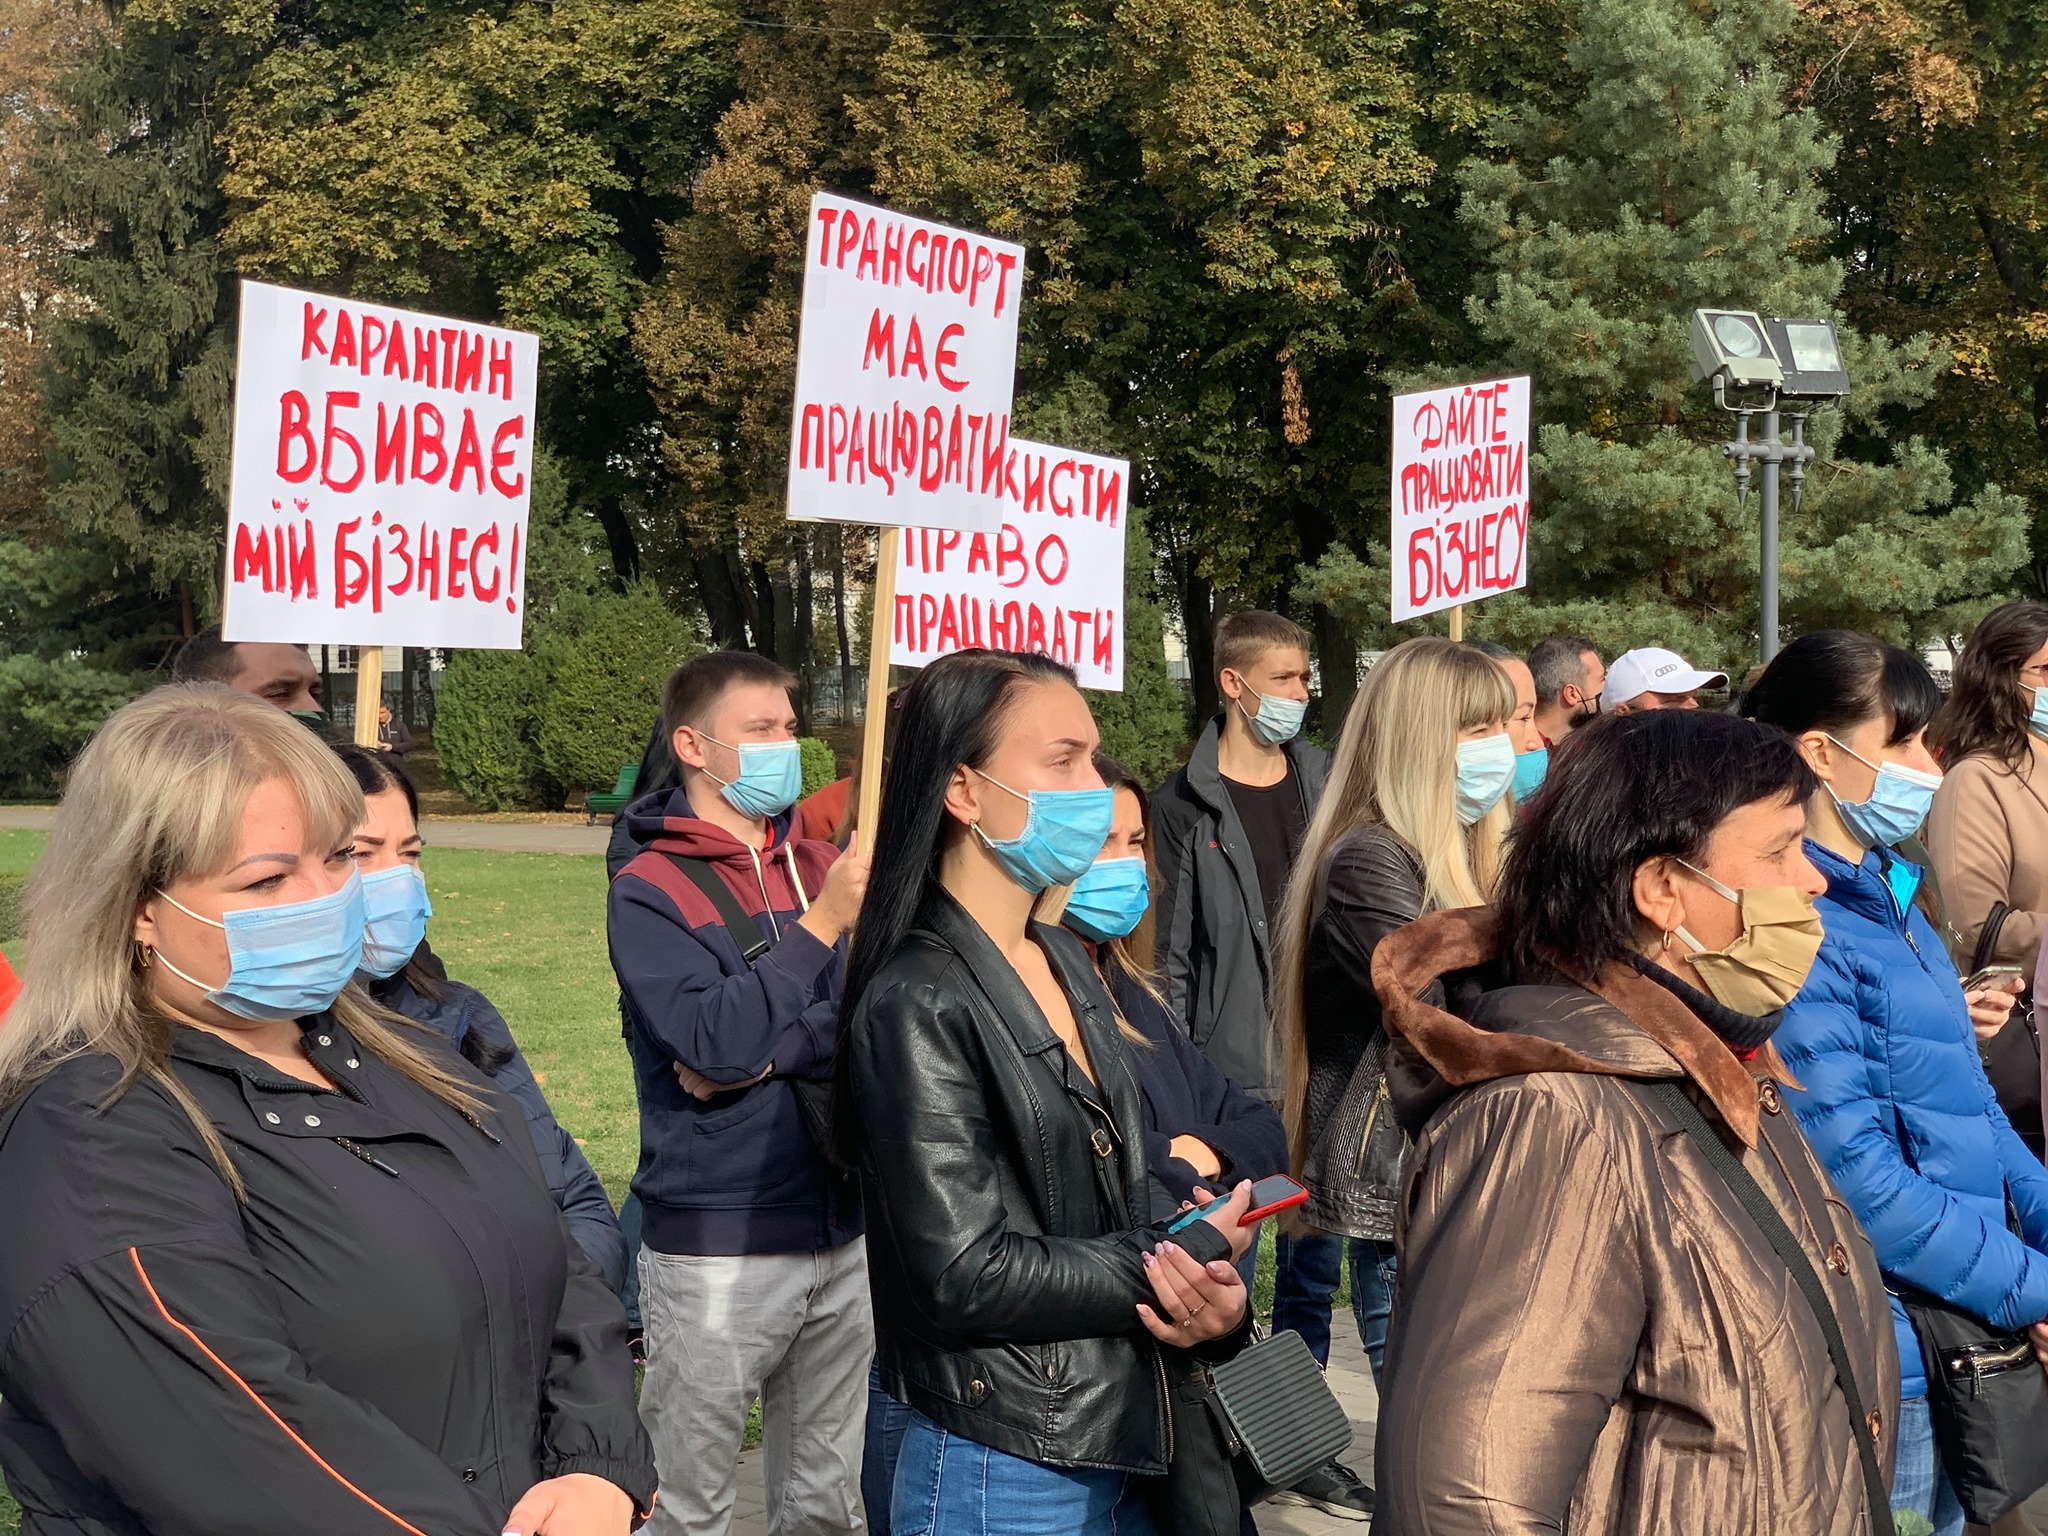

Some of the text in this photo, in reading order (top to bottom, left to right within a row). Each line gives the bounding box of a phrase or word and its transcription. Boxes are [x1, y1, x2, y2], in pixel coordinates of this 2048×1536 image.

[817, 208, 1016, 318] ТРАНСПОРТ
[301, 301, 513, 401] КАРАНТИН
[863, 307, 970, 393] МАЄ
[276, 389, 525, 500] ВБИВАЄ
[799, 400, 1008, 497] ПРАЦЮВАТИ
[1413, 383, 1509, 453] ДАЙТЕ
[1401, 440, 1523, 516] ПРАЦЮВАТИ
[333, 509, 520, 615] БІЗНЕС!
[905, 523, 1069, 588] ПРАВО
[1408, 500, 1529, 608] БІЗНЕСУ
[894, 592, 1114, 675] ПРАЦЮВАТИ
